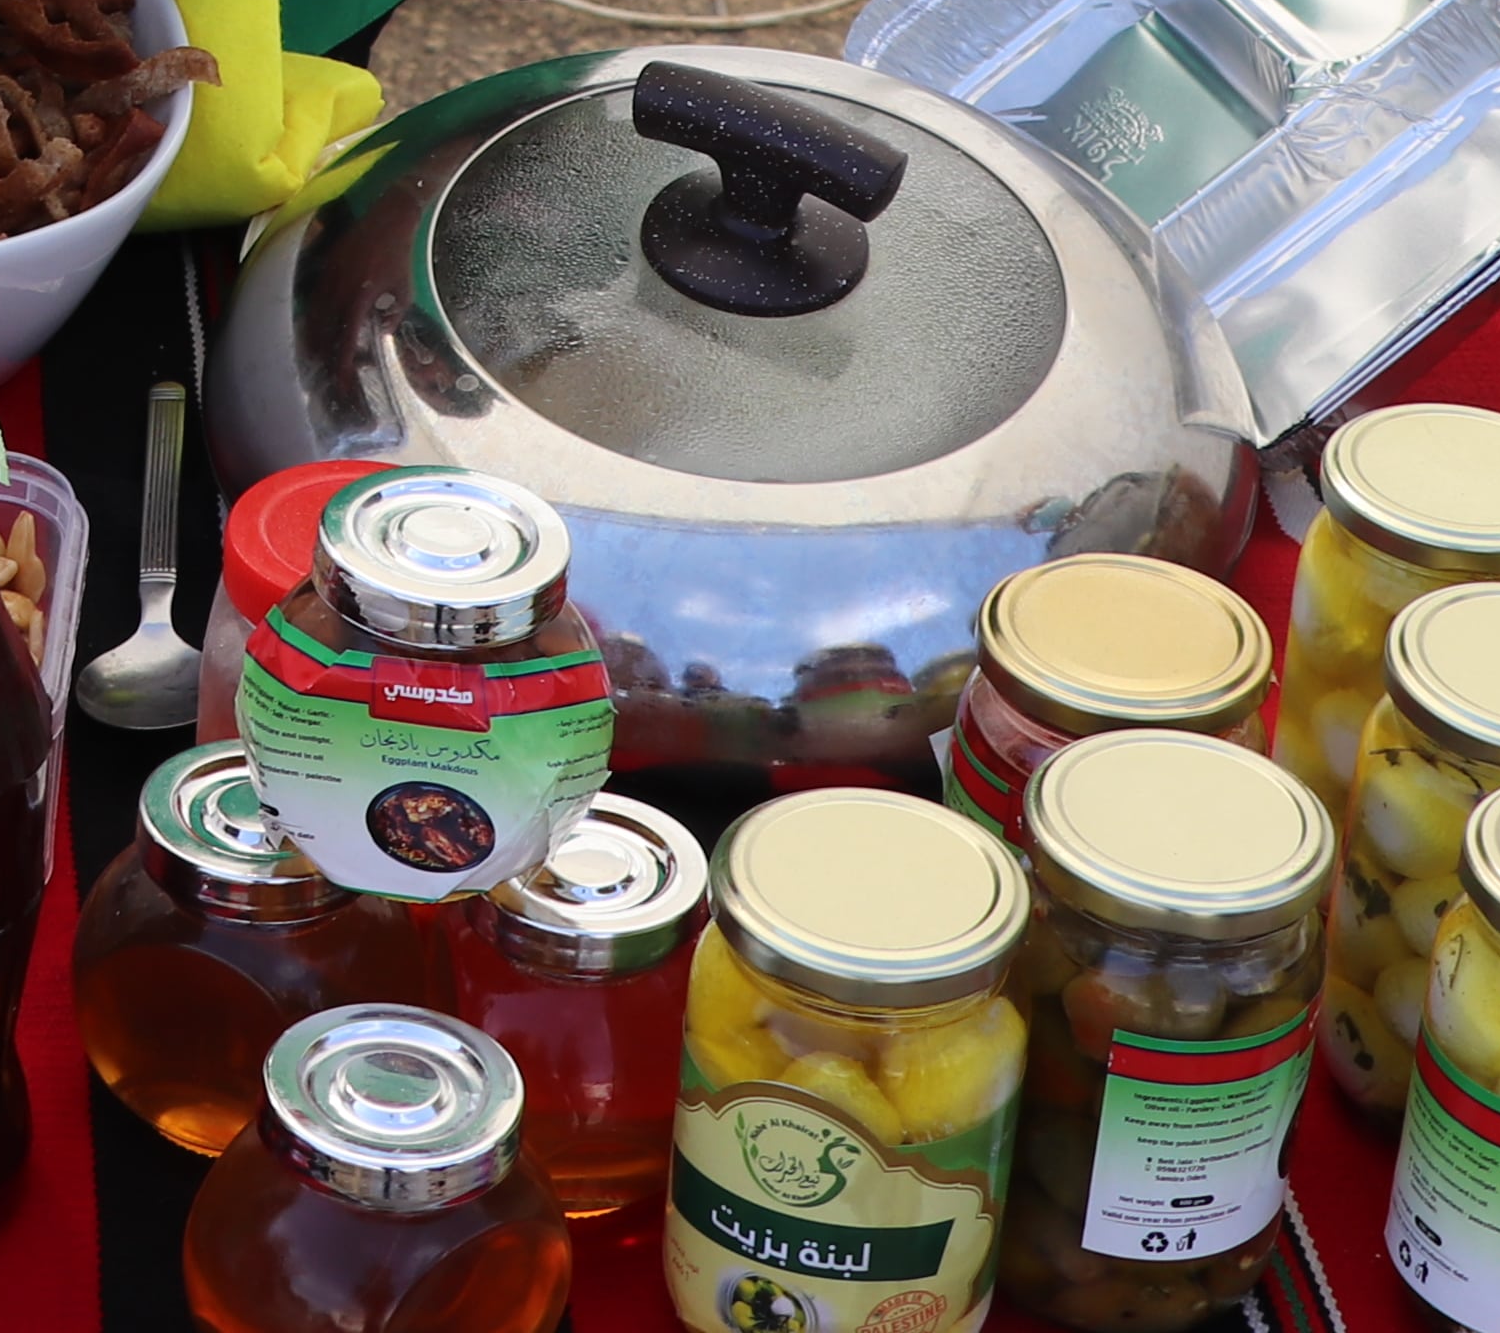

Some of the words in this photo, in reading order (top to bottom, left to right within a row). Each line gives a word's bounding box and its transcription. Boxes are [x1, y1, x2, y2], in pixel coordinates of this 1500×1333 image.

[383, 682, 474, 704] مكدوسي
[381, 754, 429, 769] Eggplant
[429, 760, 479, 776] Makdous
[709, 1204, 789, 1268] بزيت
[797, 1239, 872, 1278] لبنة
